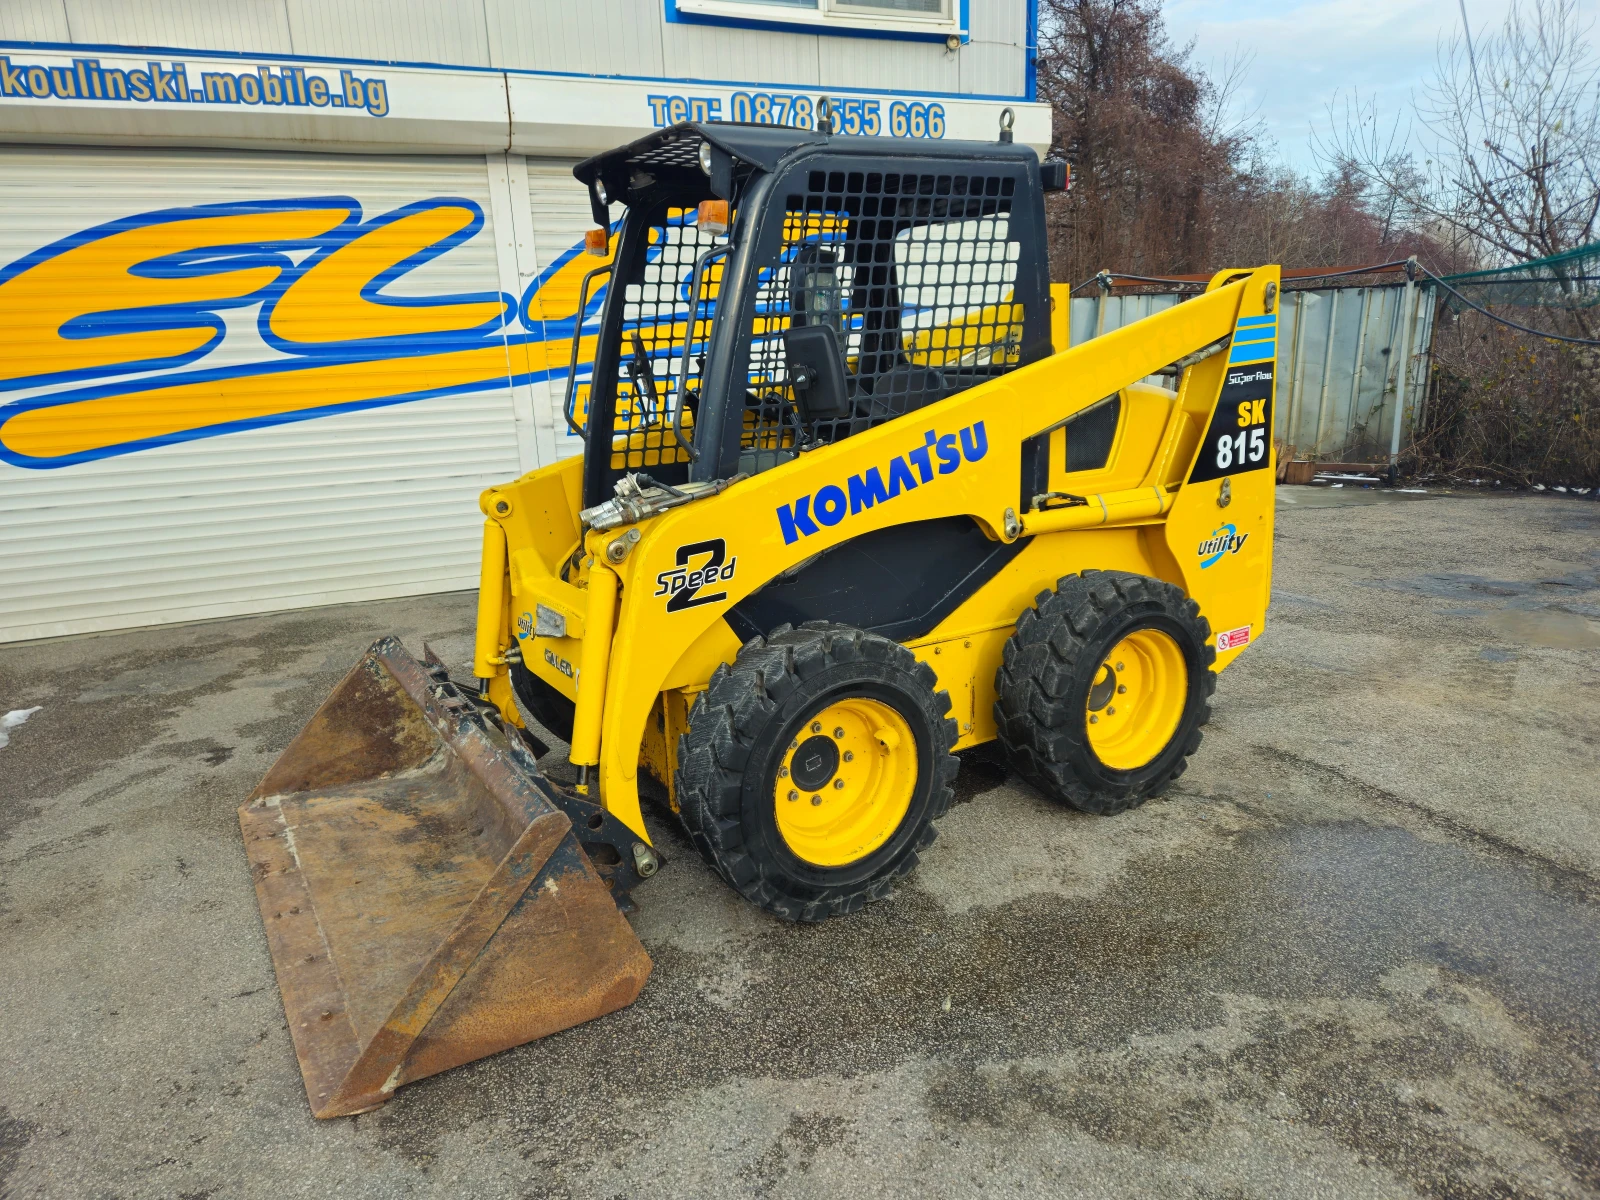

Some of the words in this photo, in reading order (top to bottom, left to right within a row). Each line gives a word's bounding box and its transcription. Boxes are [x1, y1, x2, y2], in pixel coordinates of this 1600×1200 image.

[731, 91, 814, 131] 0878
[890, 101, 945, 139] 666
[1237, 398, 1266, 428] SK
[1216, 427, 1265, 469] 815
[775, 419, 989, 546] KOMATSU
[1197, 532, 1249, 556] Utility
[654, 555, 738, 597] Speed
[666, 537, 727, 614] 2
